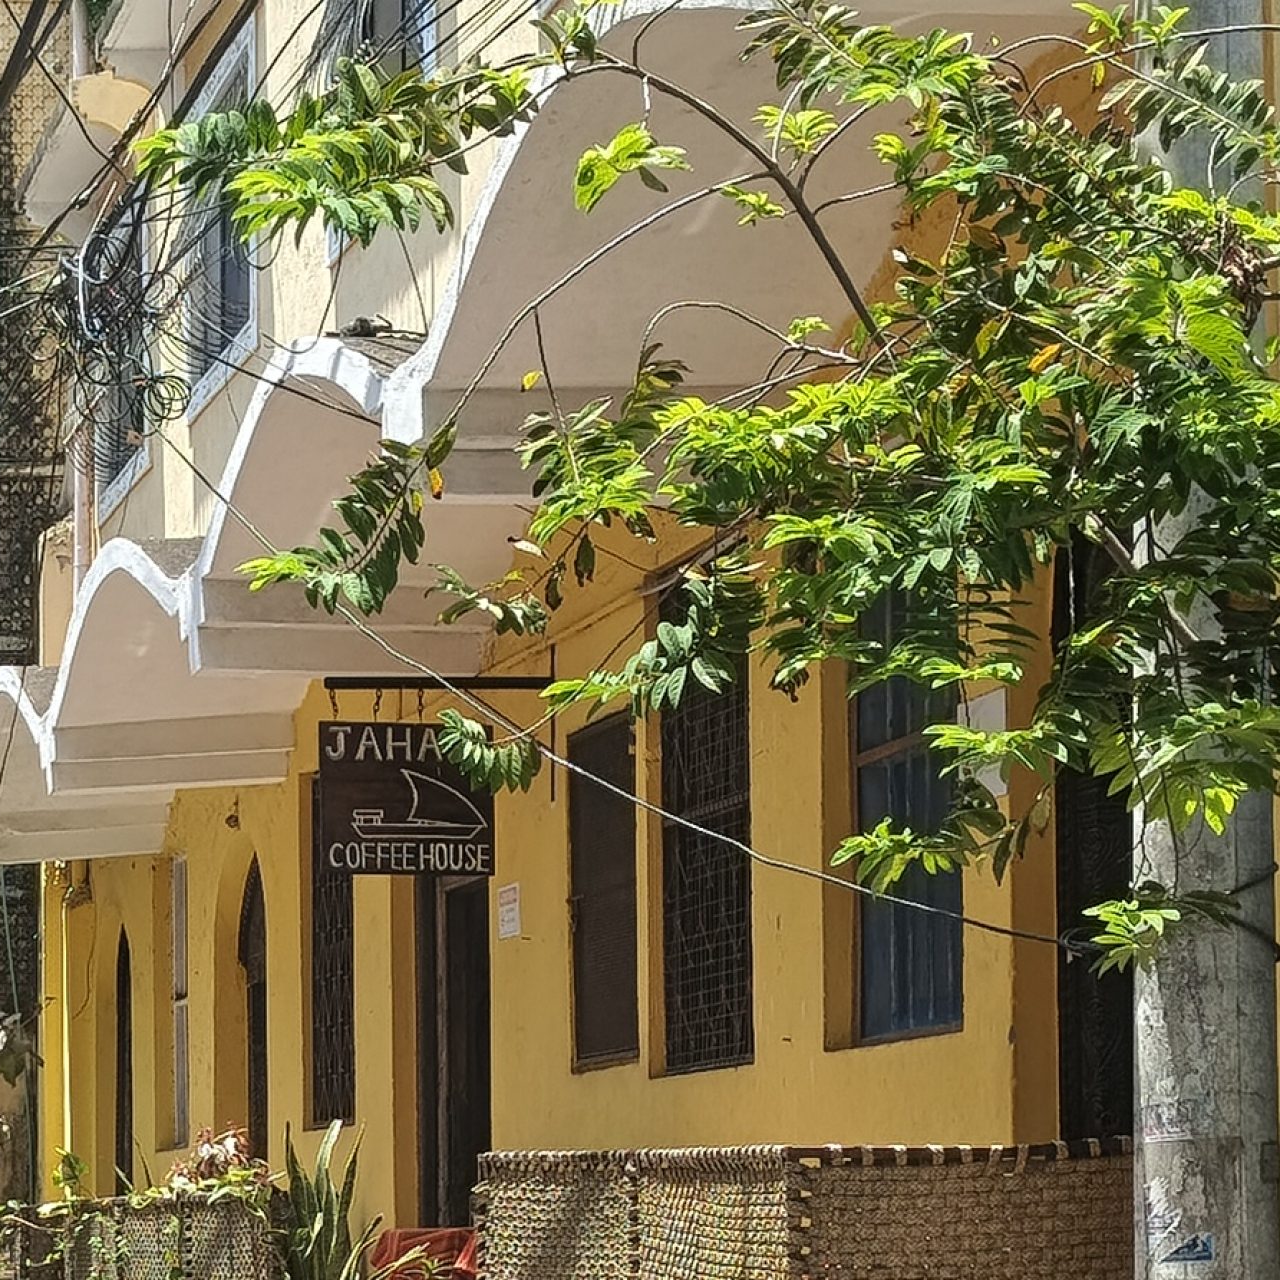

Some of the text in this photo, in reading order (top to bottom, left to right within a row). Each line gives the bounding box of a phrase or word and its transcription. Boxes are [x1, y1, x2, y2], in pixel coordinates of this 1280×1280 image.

[325, 726, 444, 762] JAHA
[329, 842, 490, 872] COFFEE HOUSE
